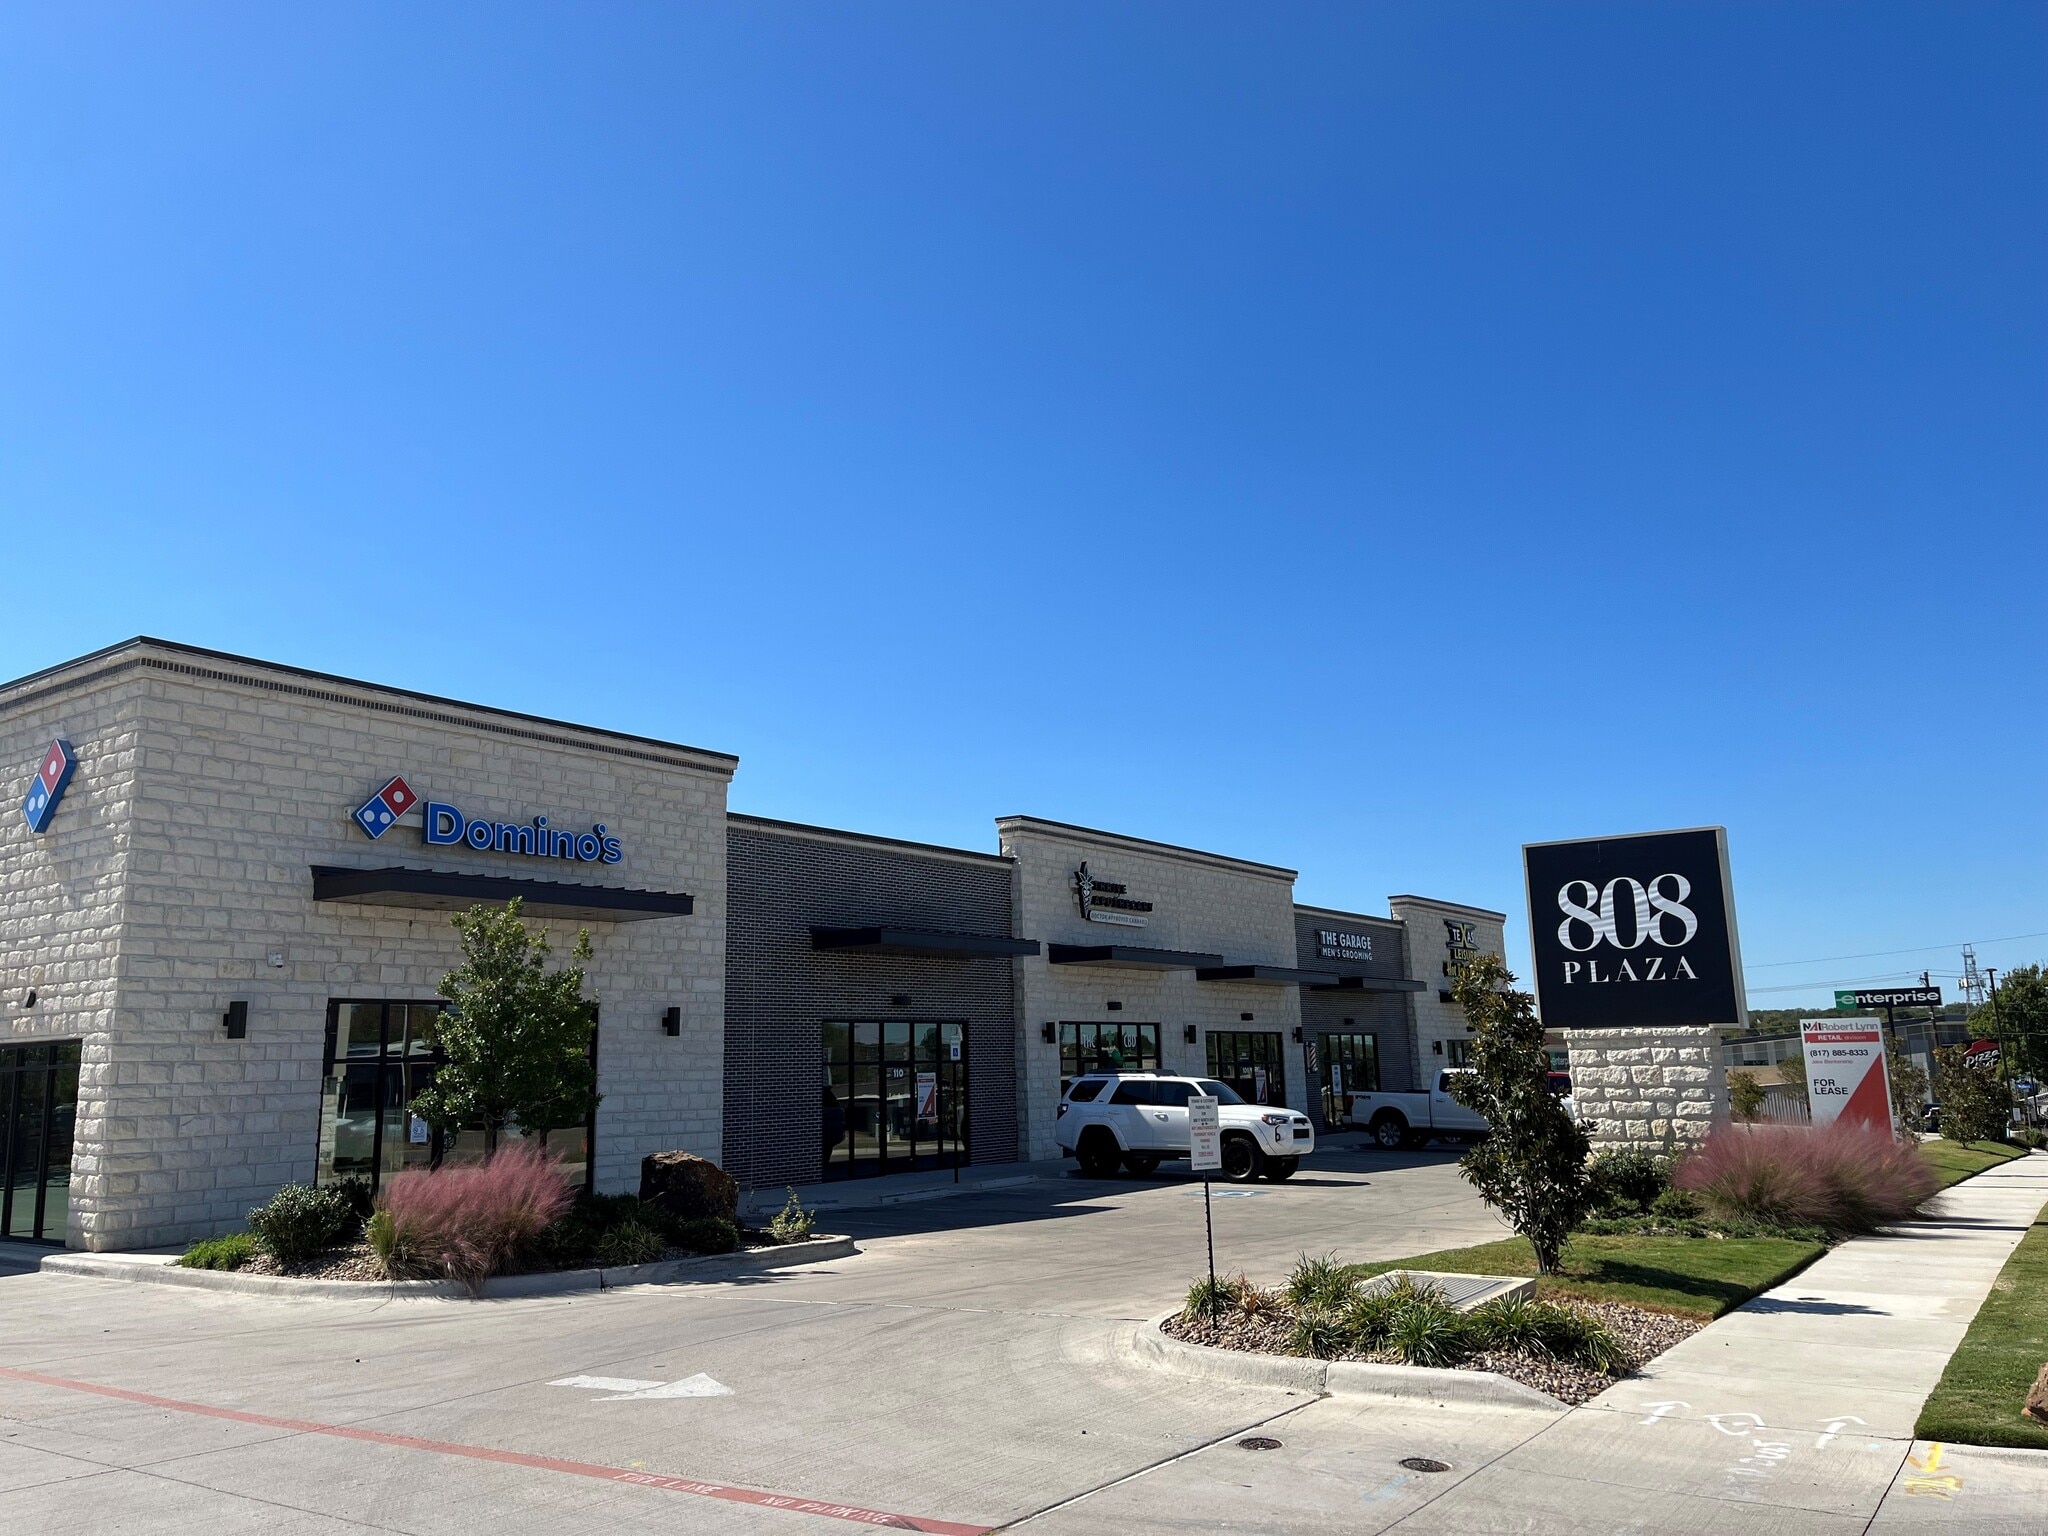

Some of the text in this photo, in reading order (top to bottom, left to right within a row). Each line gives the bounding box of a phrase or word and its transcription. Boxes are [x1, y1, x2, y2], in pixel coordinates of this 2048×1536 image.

[424, 801, 624, 864] Domino's
[1558, 873, 1698, 951] 808
[1321, 931, 1372, 950] THE GARAGE
[1341, 949, 1373, 960] GROOMING
[1562, 956, 1699, 984] PLAZA
[1836, 991, 1940, 1005] enterprise
[1855, 1022, 1879, 1031] Lynn
[1123, 1034, 1137, 1048] CBD
[1810, 1049, 1869, 1058] (817) 885-8333
[1965, 1050, 2000, 1069] Pizza
[893, 1068, 904, 1078] 110
[1813, 1079, 1836, 1087] FOR
[1814, 1087, 1849, 1095] LEASE
[613, 1473, 724, 1495] FIRE LANE
[759, 1497, 898, 1524] NO PARKING
